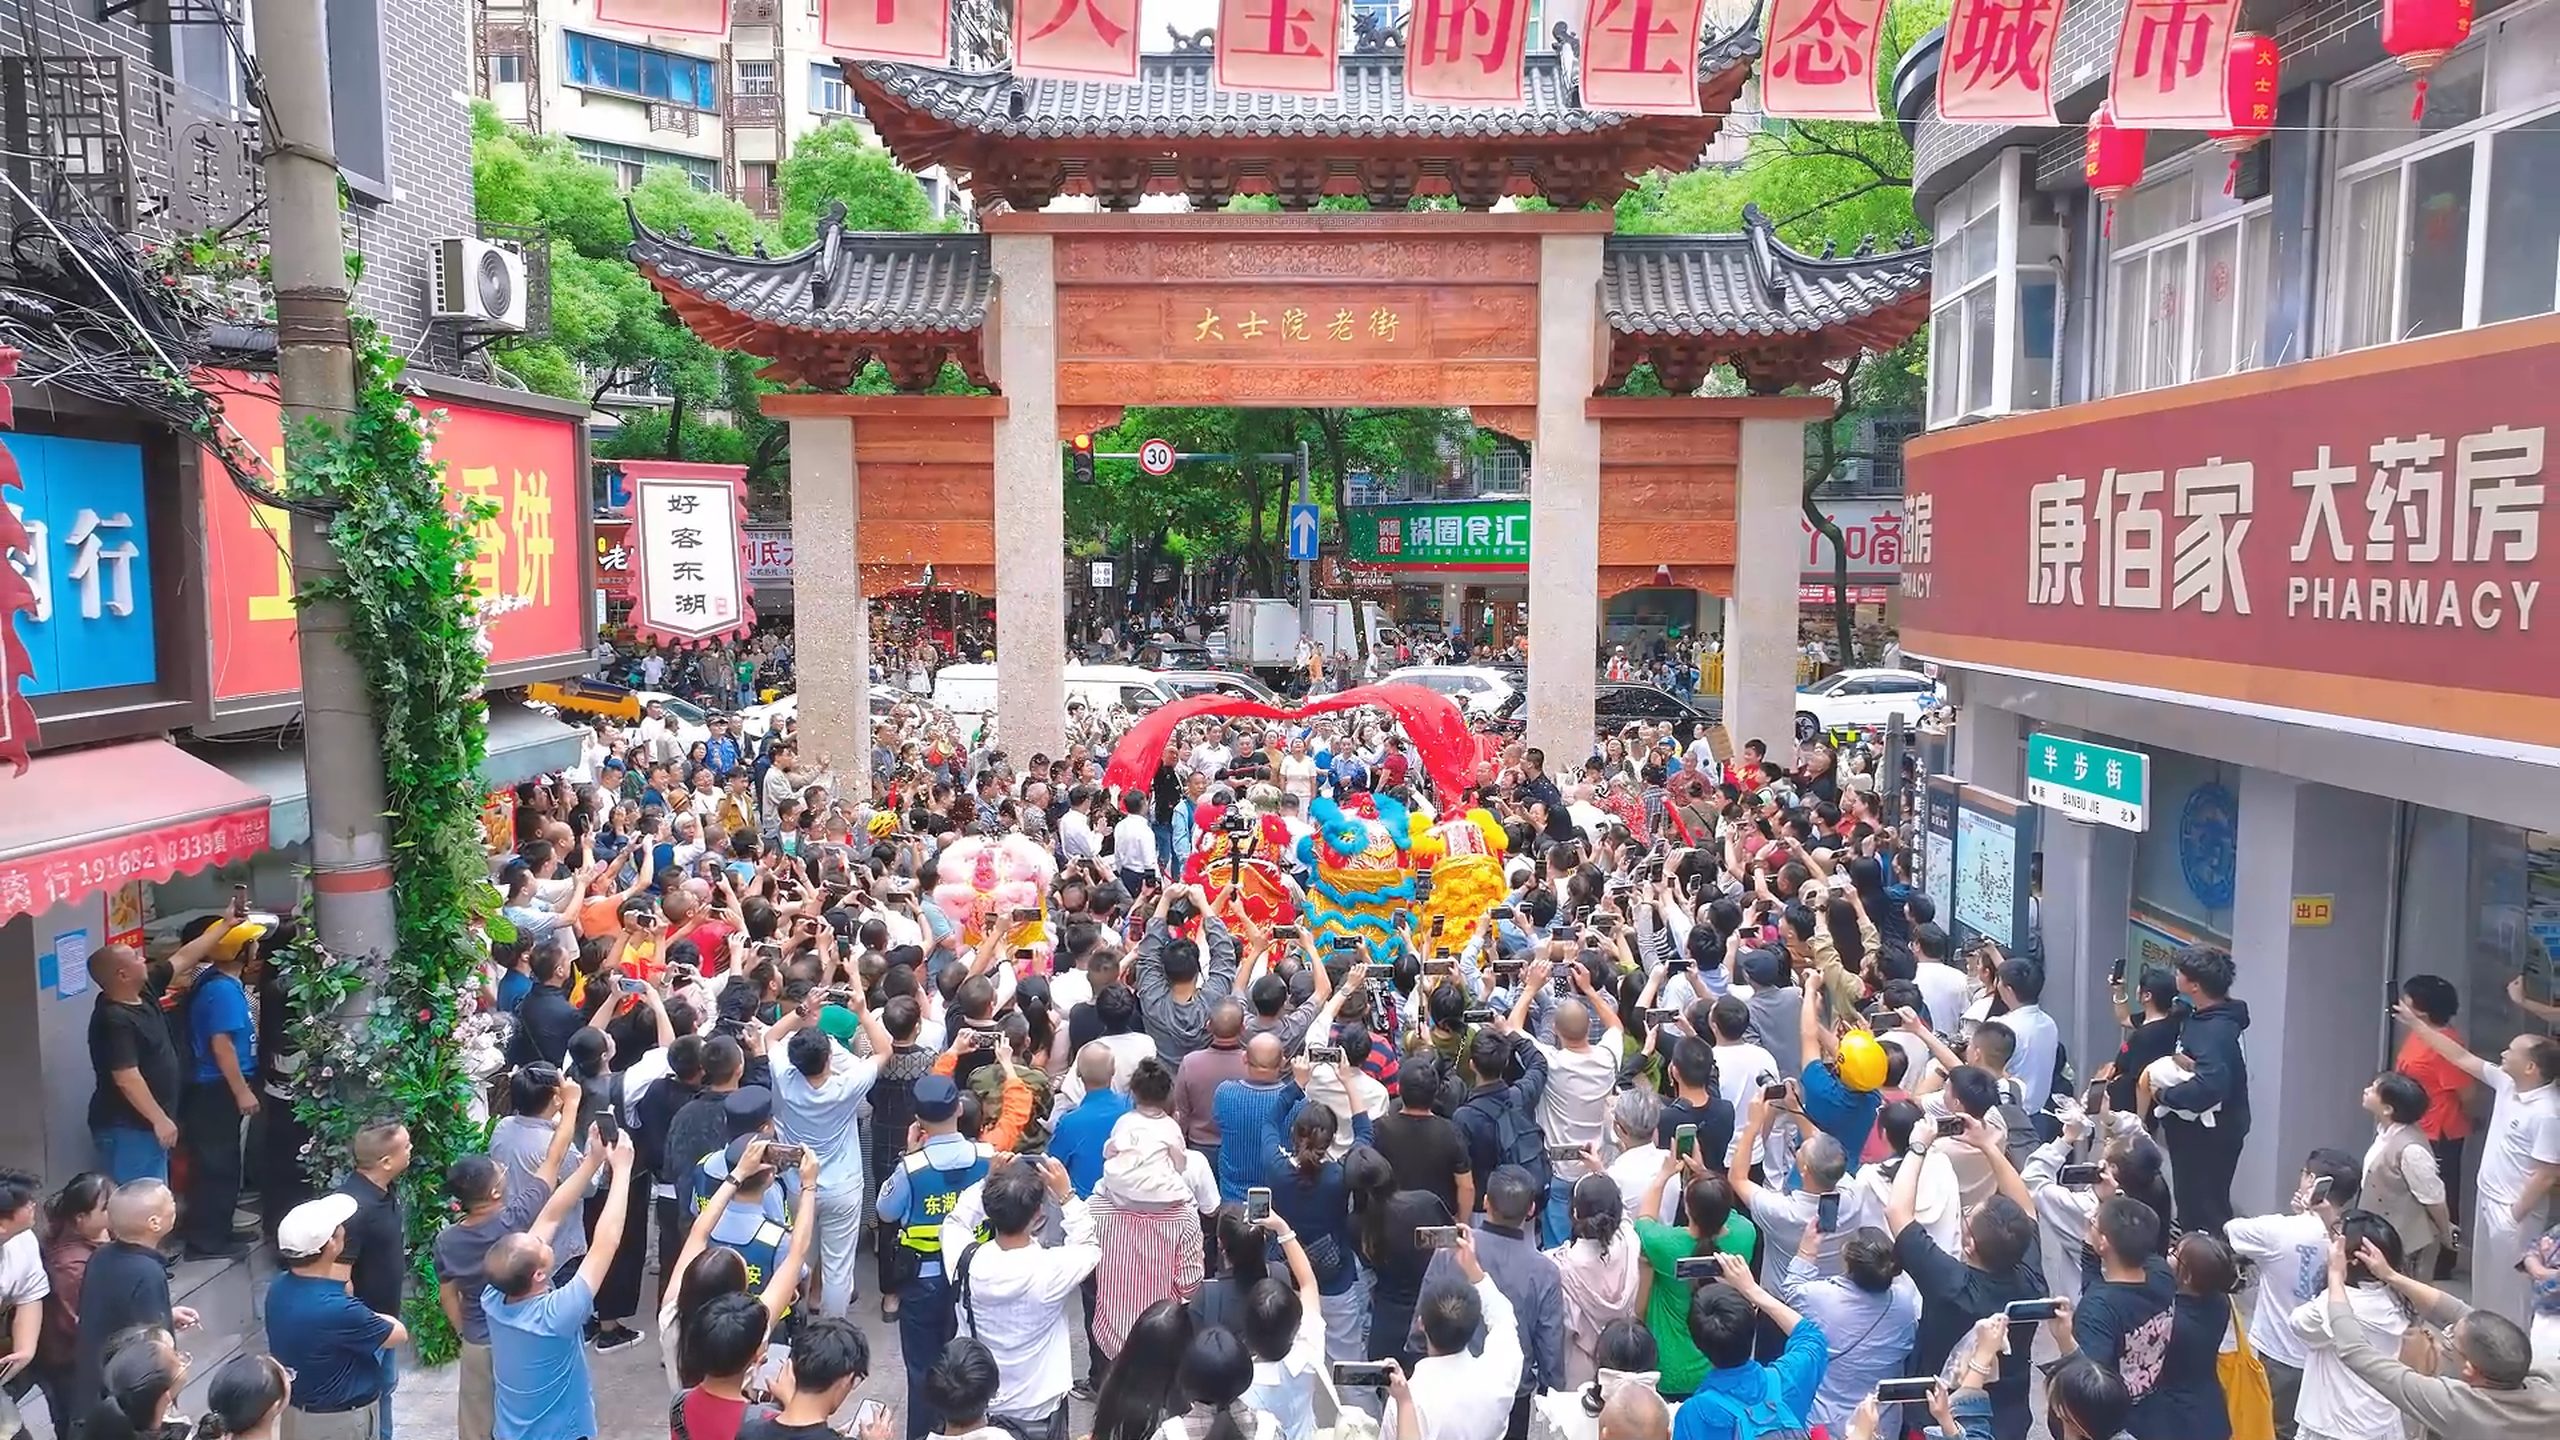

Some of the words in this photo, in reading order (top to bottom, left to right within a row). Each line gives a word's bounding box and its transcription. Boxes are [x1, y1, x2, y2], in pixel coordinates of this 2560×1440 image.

[2252, 50, 2273, 120] 大士院
[1194, 307, 1400, 344] 大士院老街
[1147, 448, 1168, 465] 30
[1409, 515, 1527, 547] 锅圈食汇
[2028, 457, 2254, 614] 康佰家
[2291, 425, 2545, 563] 大药房
[598, 541, 635, 571] 老
[667, 494, 707, 615] 好客东湖
[2288, 577, 2541, 631] PHARMACY
[2043, 745, 2122, 790] 半步街
[2063, 792, 2087, 810] BANBU
[2089, 800, 2099, 814] JIE
[2120, 807, 2128, 822] 北
[2296, 903, 2328, 918] 出口
[924, 1191, 957, 1216] 东湖
